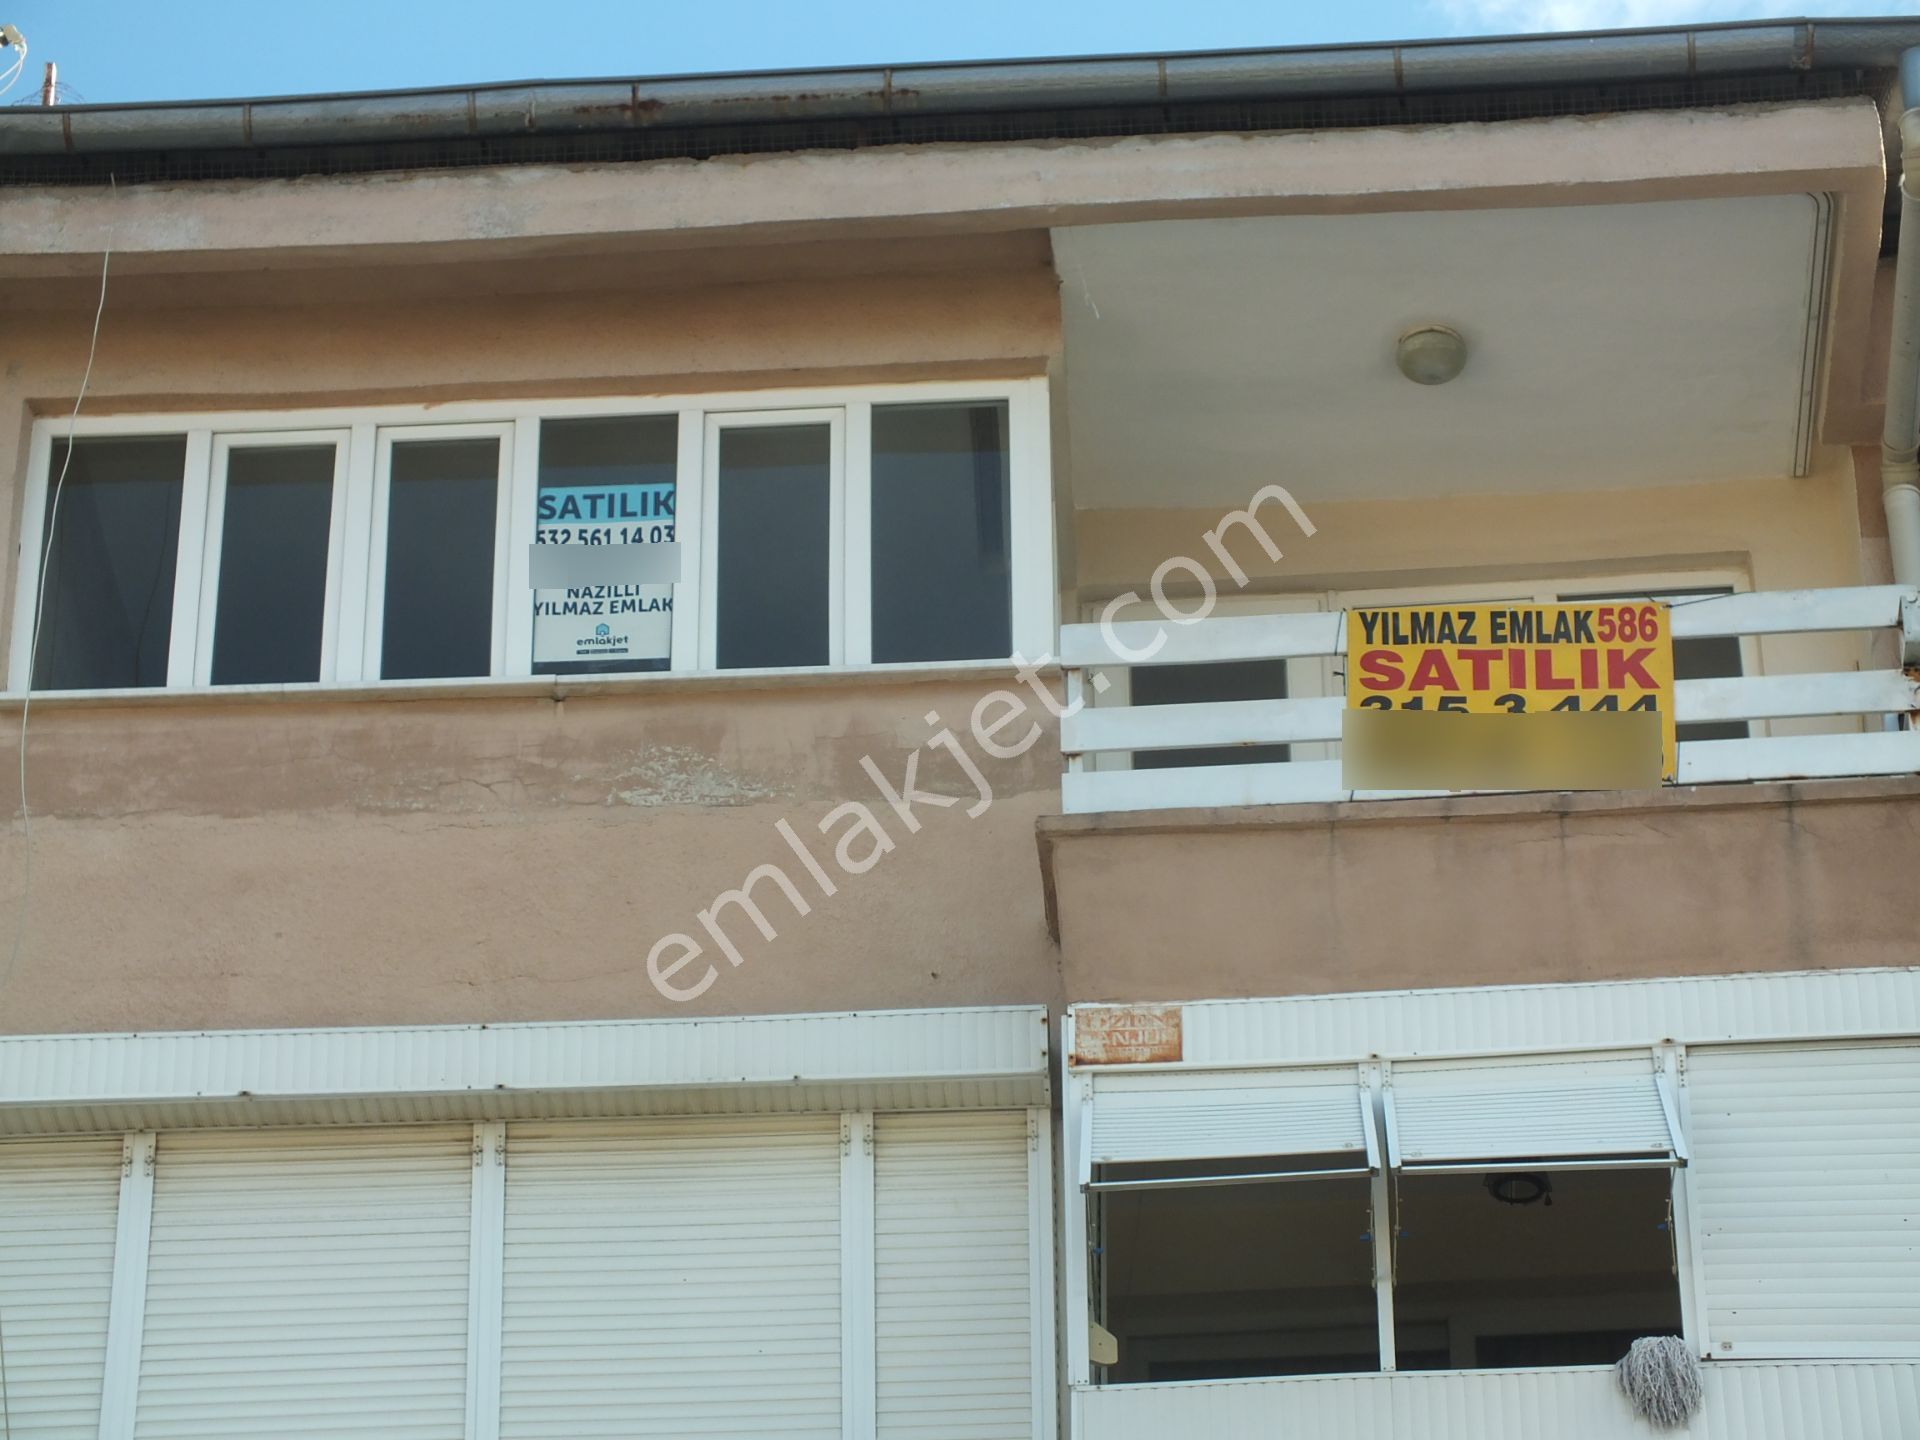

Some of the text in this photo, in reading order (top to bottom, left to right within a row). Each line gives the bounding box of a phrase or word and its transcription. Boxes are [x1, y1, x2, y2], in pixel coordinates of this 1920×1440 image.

[538, 490, 675, 519] SATILIK
[620, 526, 643, 545] 14
[534, 598, 673, 616] YILMAZ EMLAK
[1358, 605, 1659, 645] YILMAZ EMLAK 586
[576, 635, 629, 647] emlakjet
[1359, 647, 1661, 692] SATILIK
